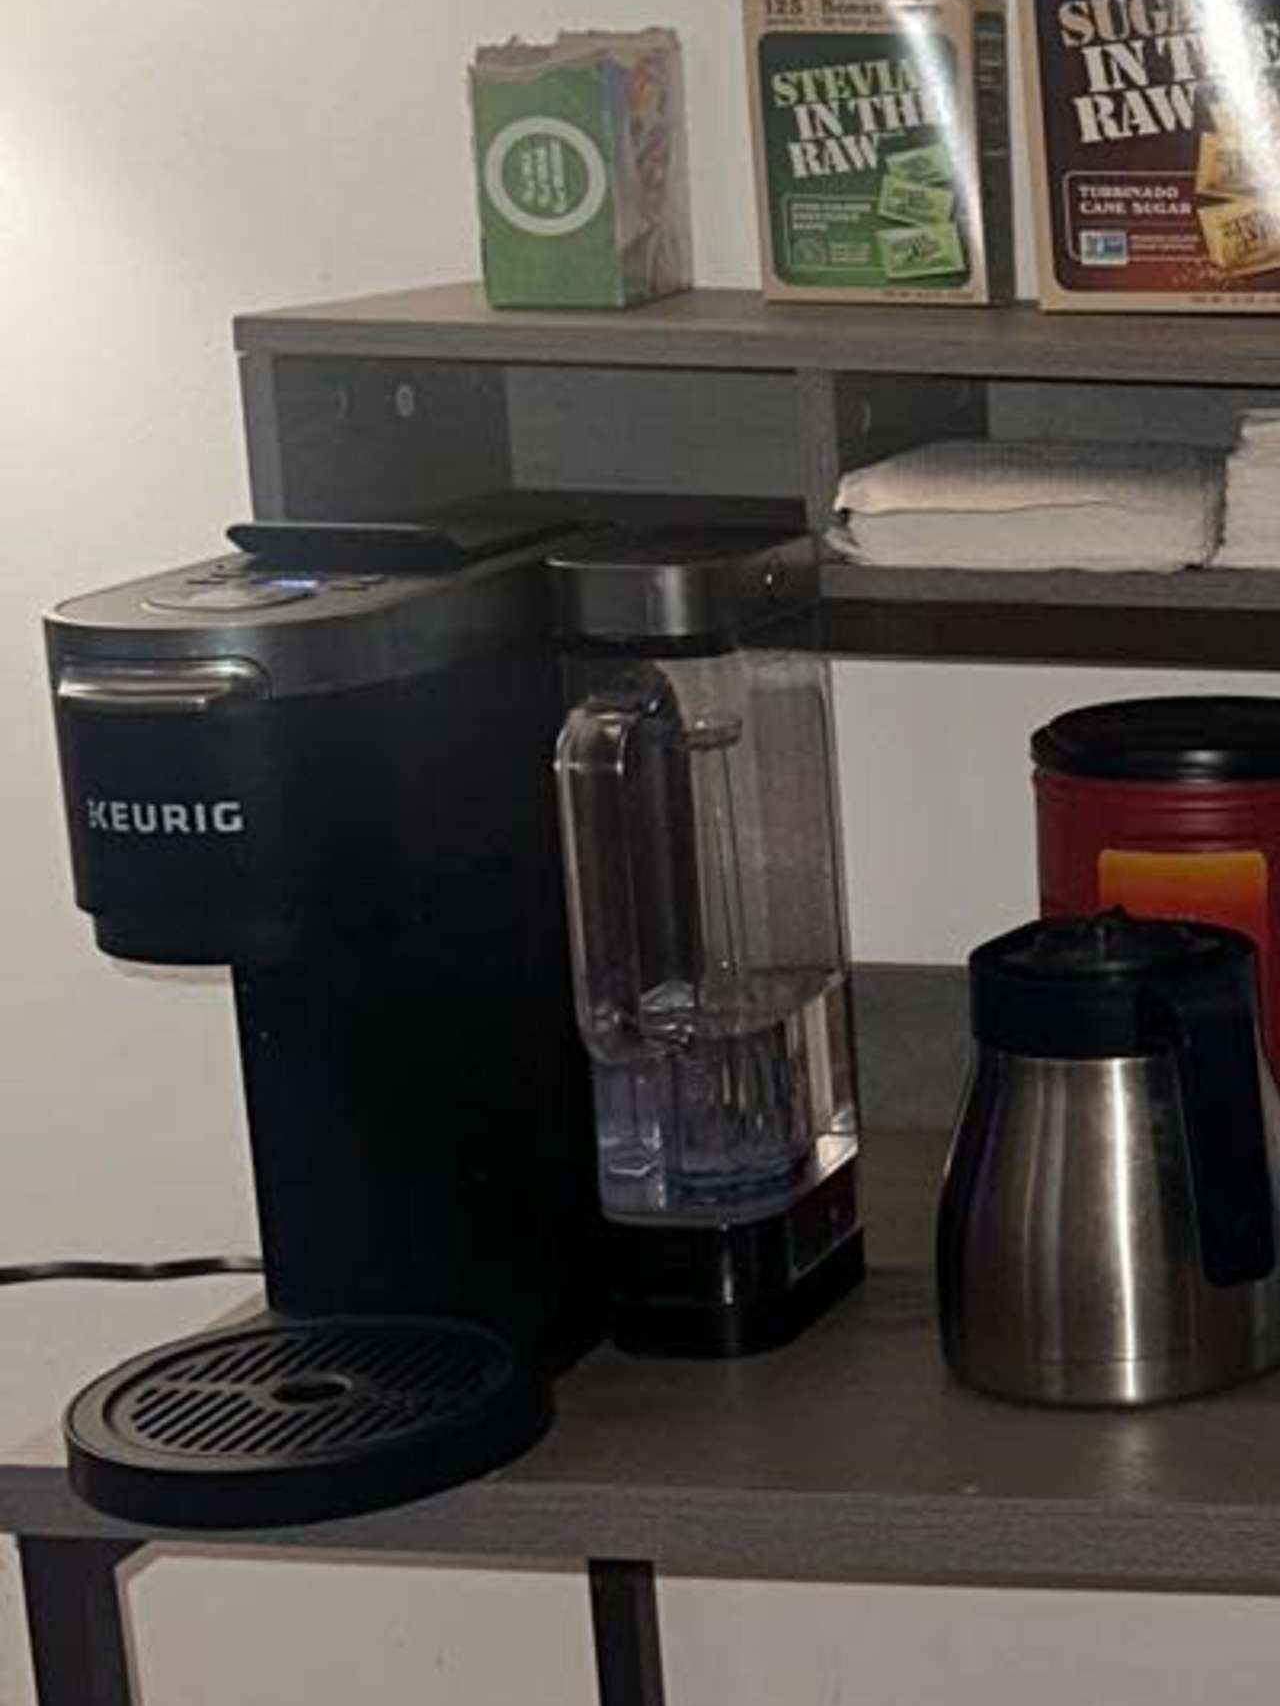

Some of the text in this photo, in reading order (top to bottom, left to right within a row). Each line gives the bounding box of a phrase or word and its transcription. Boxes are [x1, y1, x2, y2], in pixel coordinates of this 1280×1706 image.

[771, 57, 925, 108] STEVIA
[1081, 40, 1150, 93] IN
[793, 97, 844, 141] IN
[1073, 82, 1200, 143] RAW
[787, 133, 880, 179] RAW
[87, 800, 244, 834] KEURIG
